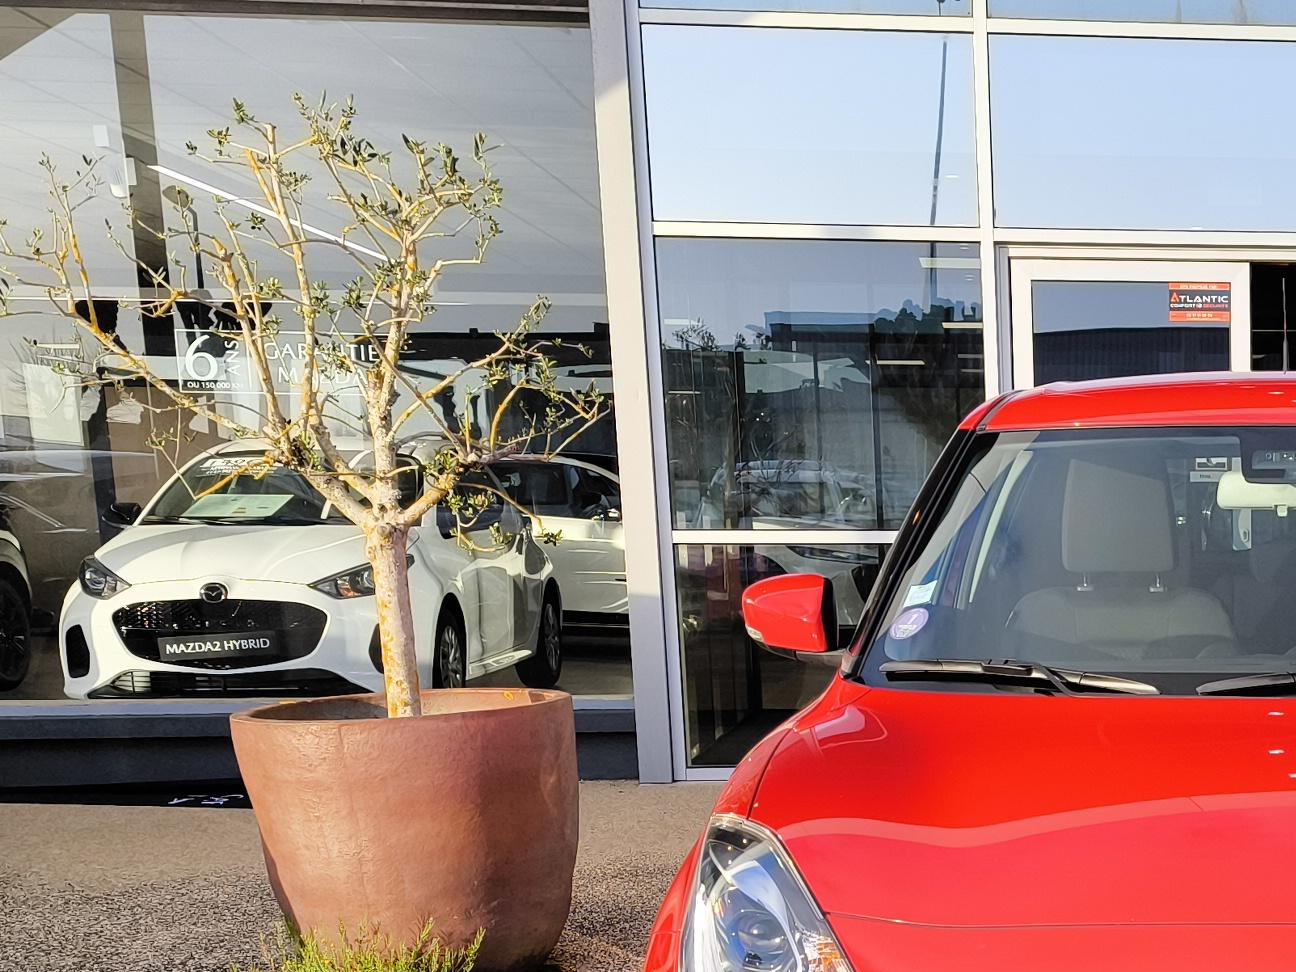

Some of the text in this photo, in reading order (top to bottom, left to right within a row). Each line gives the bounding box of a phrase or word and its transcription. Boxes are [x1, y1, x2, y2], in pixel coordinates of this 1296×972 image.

[1170, 292, 1229, 303] ATLANTIC
[185, 334, 241, 381] 6 ANS
[263, 342, 380, 362] GARTIE
[187, 381, 200, 389] OU
[201, 381, 215, 389] 150
[165, 638, 270, 654] MAZDA2 HYBRID
